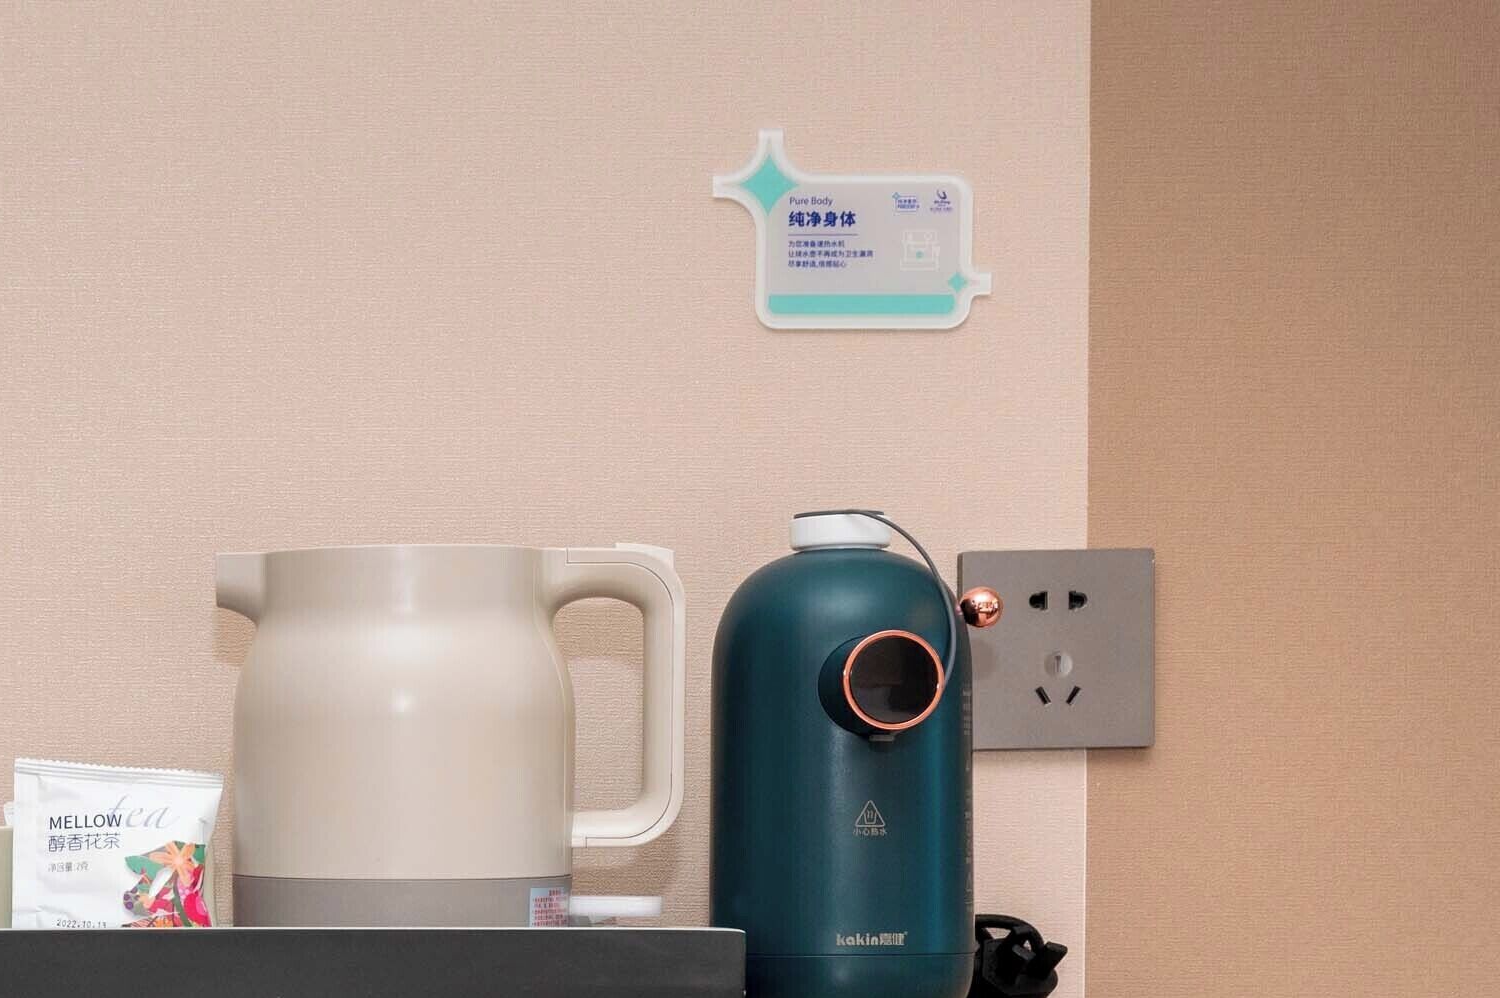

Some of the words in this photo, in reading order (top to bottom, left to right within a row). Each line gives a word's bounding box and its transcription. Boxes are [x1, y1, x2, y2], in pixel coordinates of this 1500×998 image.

[789, 196, 809, 206] Pure
[811, 196, 833, 206] Body
[788, 210, 856, 227] 纯净身体
[49, 814, 122, 830] MELLOW
[48, 833, 120, 852] 醇香花茶
